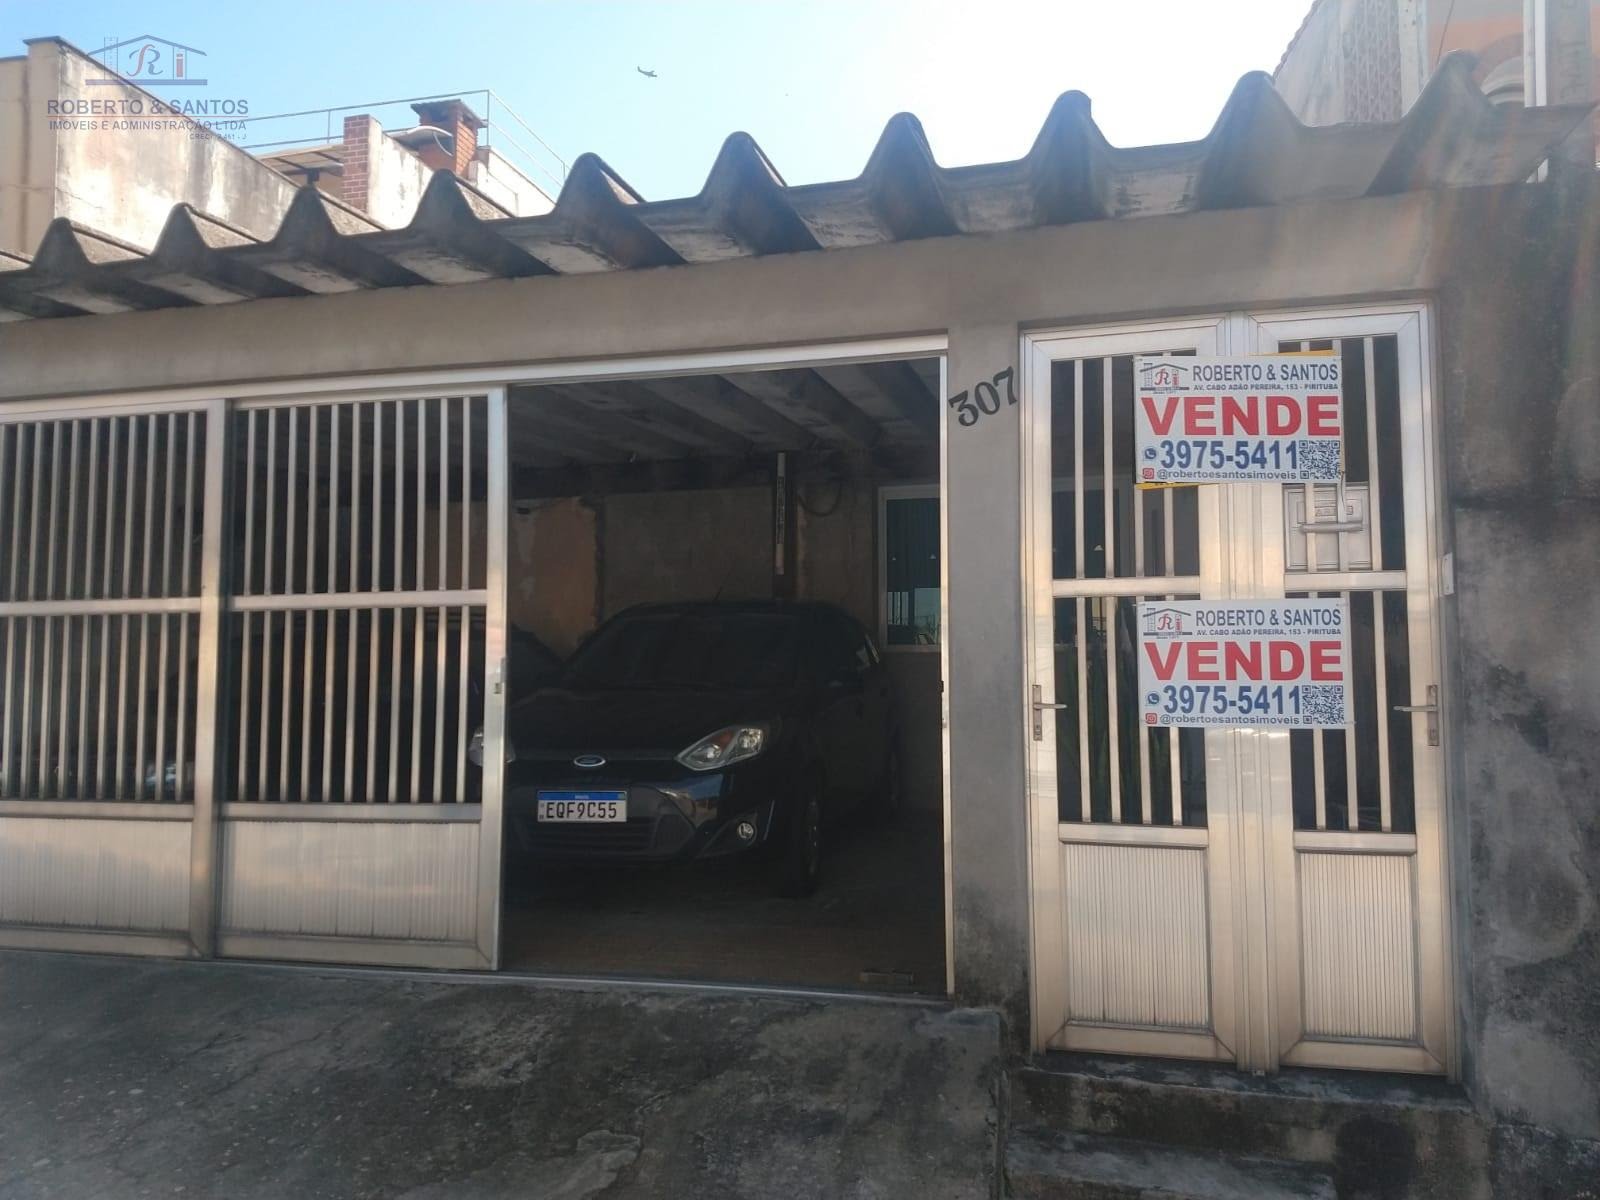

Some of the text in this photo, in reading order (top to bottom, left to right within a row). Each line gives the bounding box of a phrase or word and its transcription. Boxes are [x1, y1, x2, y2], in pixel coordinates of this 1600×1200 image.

[1193, 363, 1338, 382] ROBERTO & SANTOS
[948, 365, 1018, 427] 307
[1141, 395, 1340, 436] VENDE
[1160, 440, 1297, 469] 3975-5411
[1156, 469, 1297, 480] @robertoesantosimoveis
[1196, 608, 1341, 626] ROBERTO & SANTOS
[1143, 641, 1343, 681] VENDE
[1163, 685, 1300, 714] 3975-5411
[1159, 714, 1300, 725] @robertoesantosimoveis
[546, 801, 617, 819] EQF9C55
